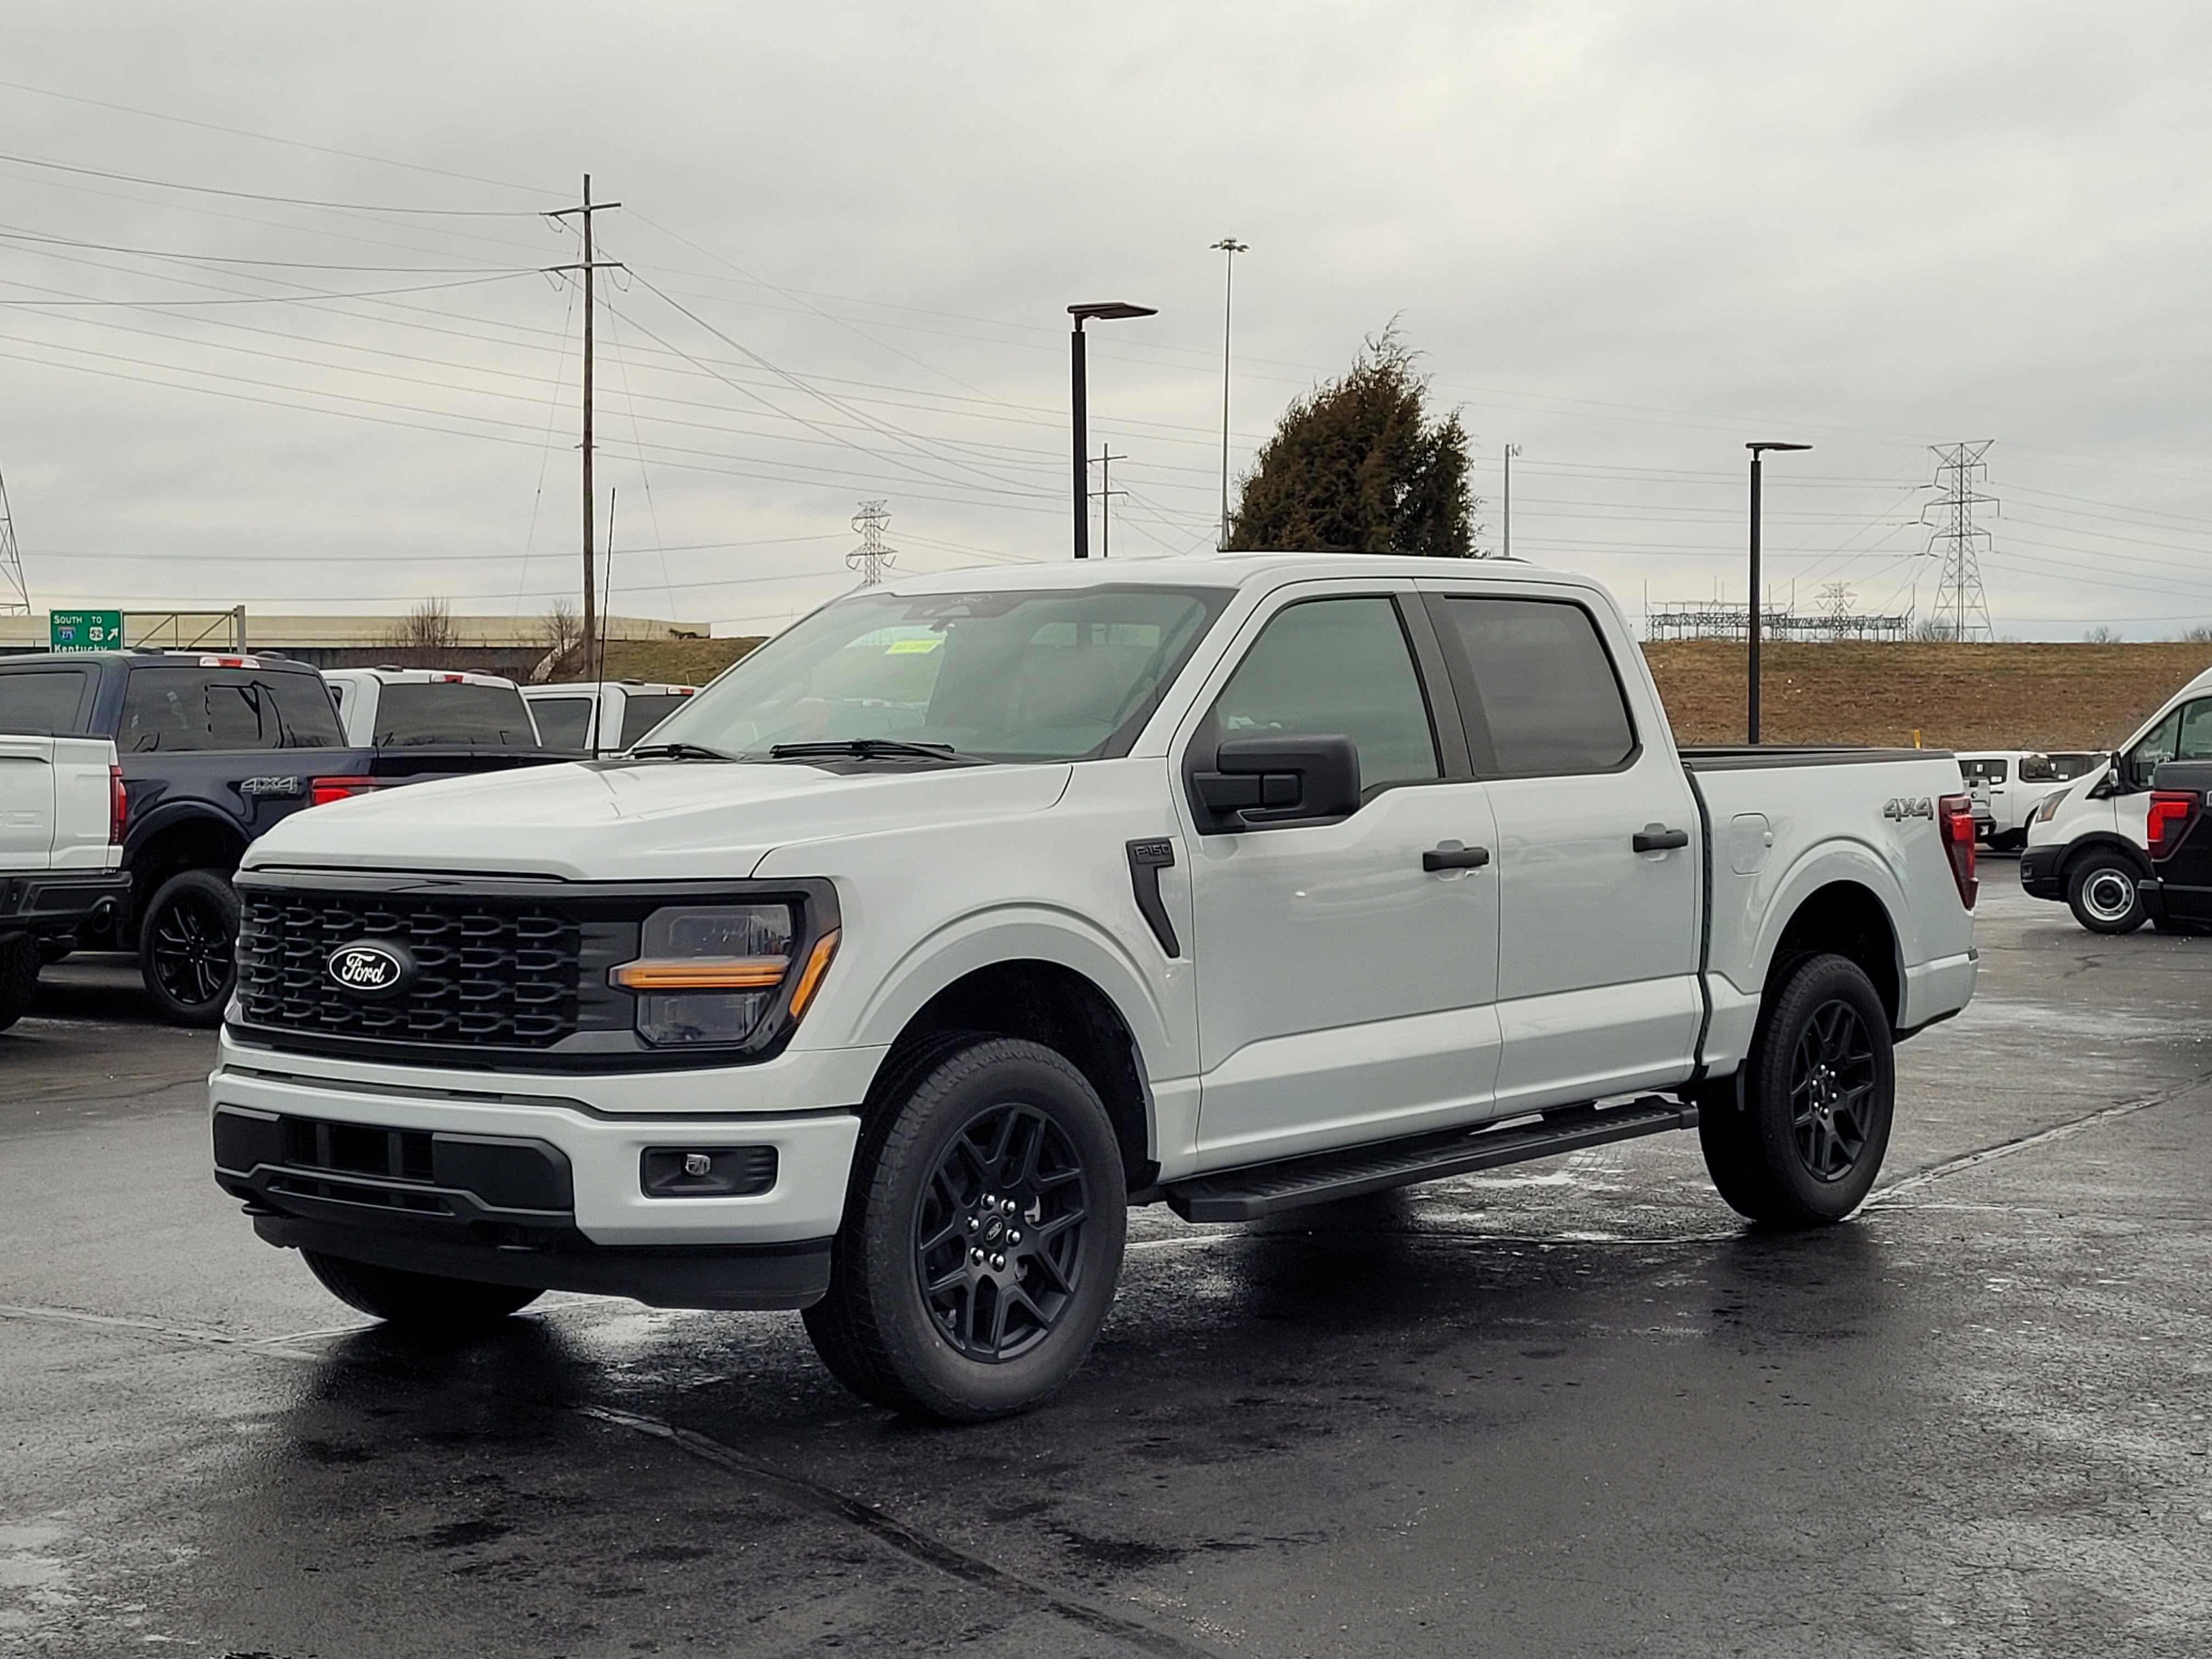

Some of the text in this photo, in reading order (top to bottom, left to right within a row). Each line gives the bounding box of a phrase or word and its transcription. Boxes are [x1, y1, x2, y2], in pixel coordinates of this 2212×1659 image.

[54, 614, 82, 624] SOUTH
[91, 630, 101, 639] 52
[342, 952, 386, 984] Ford
